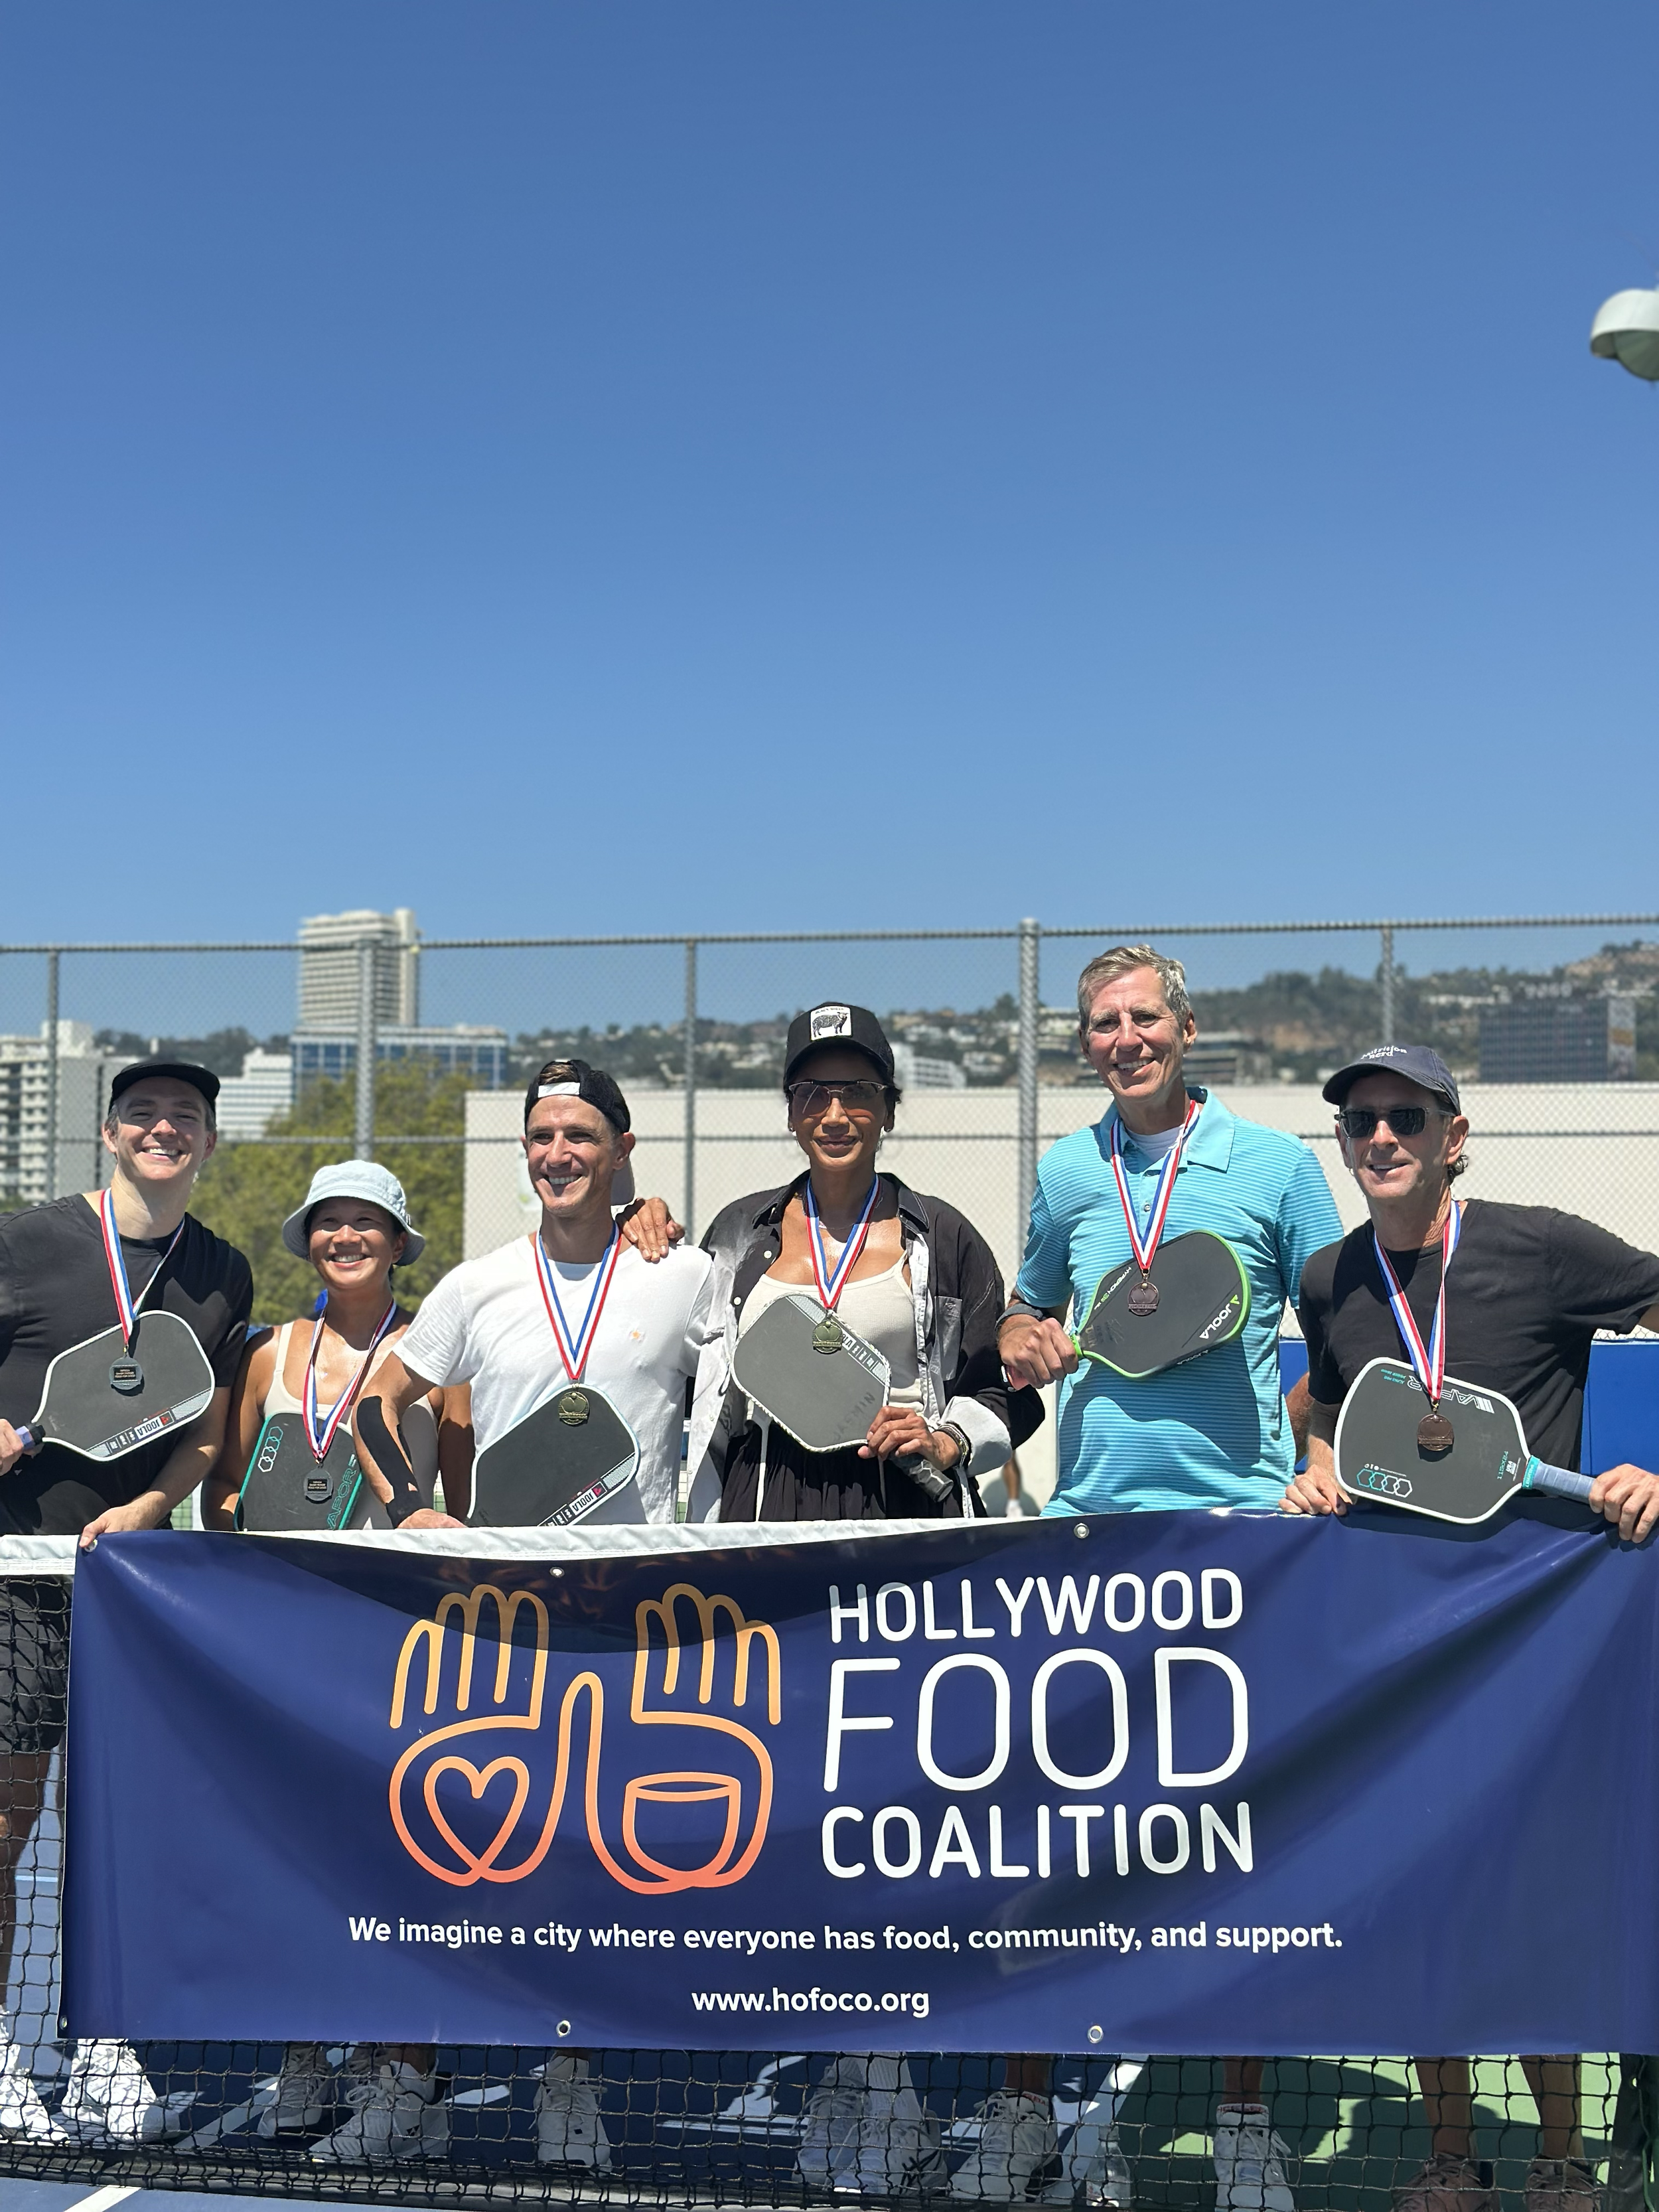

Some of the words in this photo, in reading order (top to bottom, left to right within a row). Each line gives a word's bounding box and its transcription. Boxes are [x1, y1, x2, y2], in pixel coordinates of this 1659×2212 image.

[1368, 1047, 1394, 1059] nerd
[1199, 1303, 1232, 1339] JOOLA
[1407, 1375, 1482, 1411] VAPR
[137, 1419, 161, 1436] JOOLA
[572, 1492, 594, 1512] JOOLA
[829, 1568, 1243, 1644] HOLLYWOOD
[824, 1647, 1249, 1793] FOOD
[822, 1801, 1254, 1879] COALITION
[348, 1917, 392, 1942] We
[399, 1917, 503, 1949] imagine
[510, 1927, 526, 1945] a
[534, 1921, 582, 1953] city
[588, 1923, 676, 1949] where
[684, 1925, 816, 1955] everyone
[824, 1925, 875, 1950] has
[883, 1925, 960, 1953] food,
[968, 1921, 1142, 1953] community,
[1151, 1921, 1206, 1947] and
[1216, 1922, 1342, 1953] support.
[691, 1987, 930, 2018] www.hofoco.org
